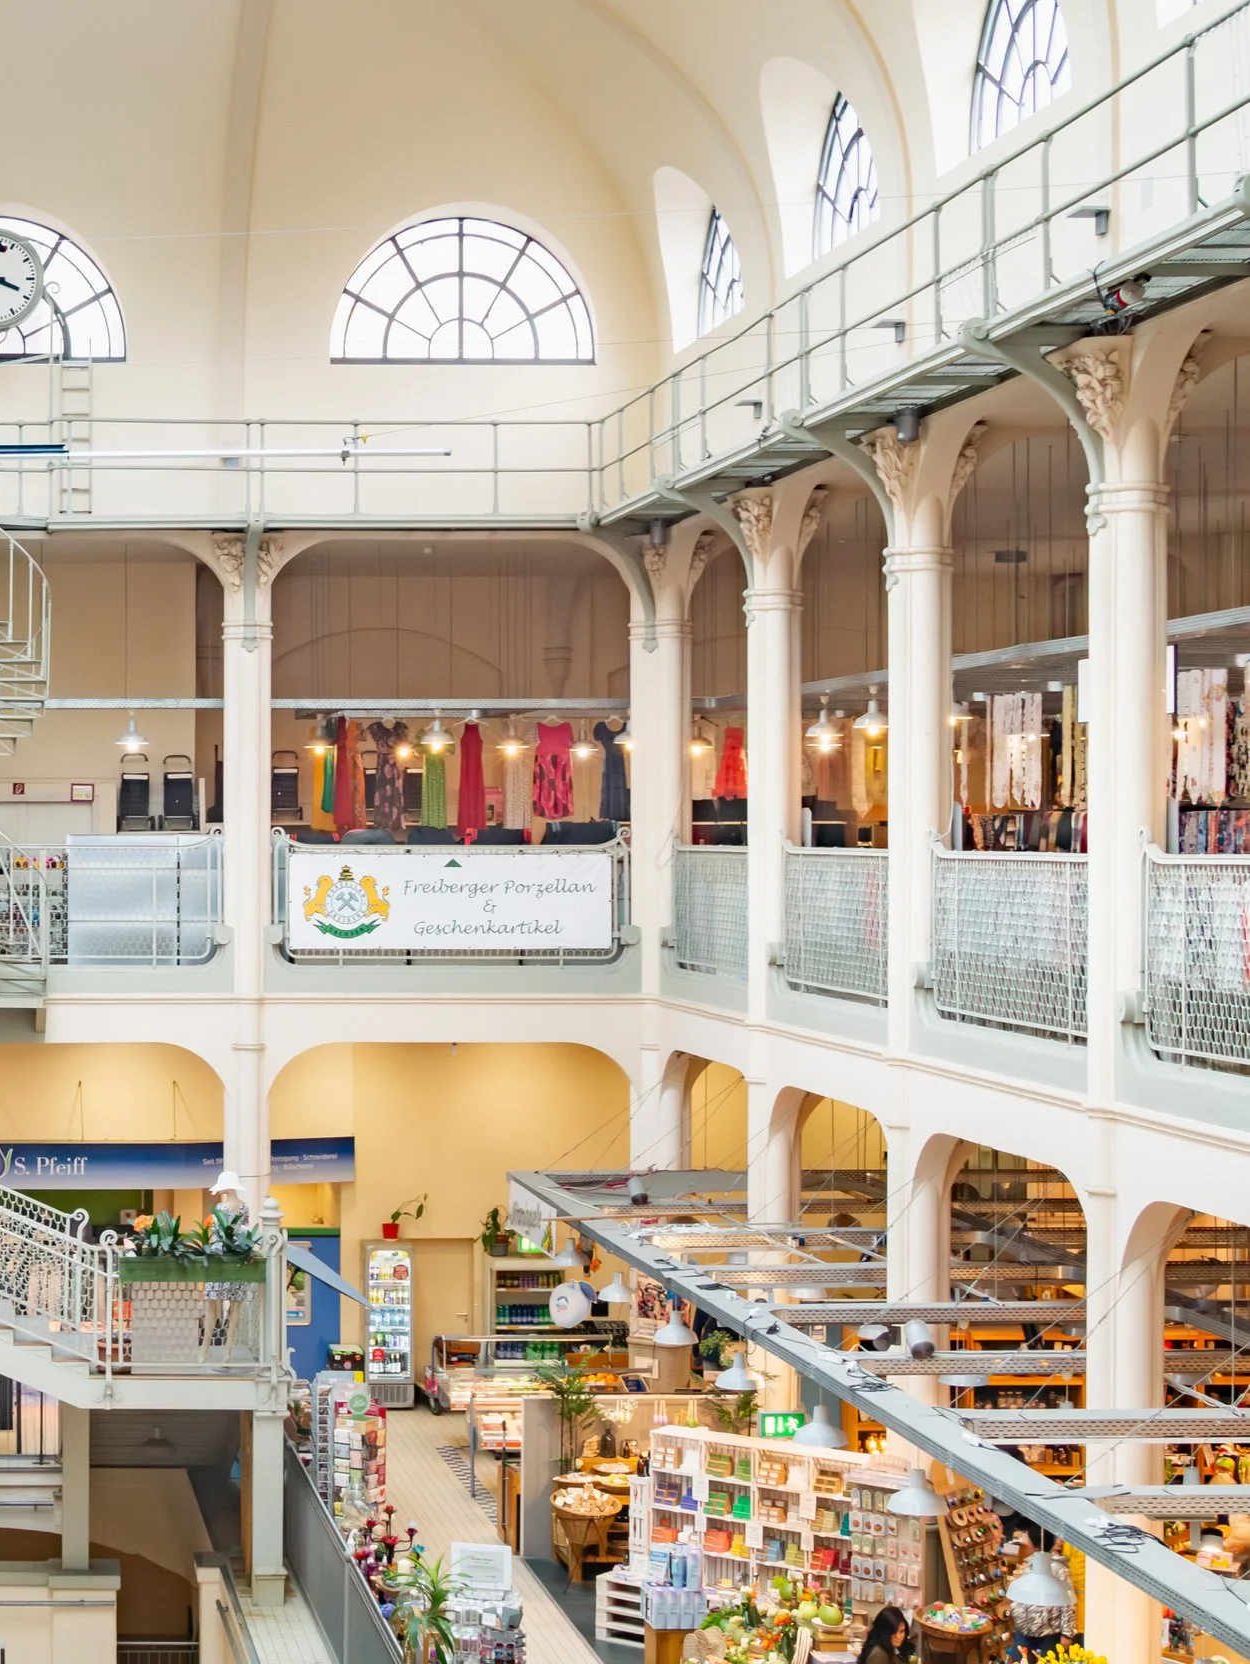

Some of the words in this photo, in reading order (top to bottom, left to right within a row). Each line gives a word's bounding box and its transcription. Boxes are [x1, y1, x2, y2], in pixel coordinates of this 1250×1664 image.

[403, 878, 500, 898] Freiberger
[503, 878, 597, 898] Porzellan
[482, 899, 498, 914] &
[413, 919, 565, 936] Geschenkartikel
[13, 1156, 30, 1176] S.
[35, 1155, 88, 1176] Pfeiff
